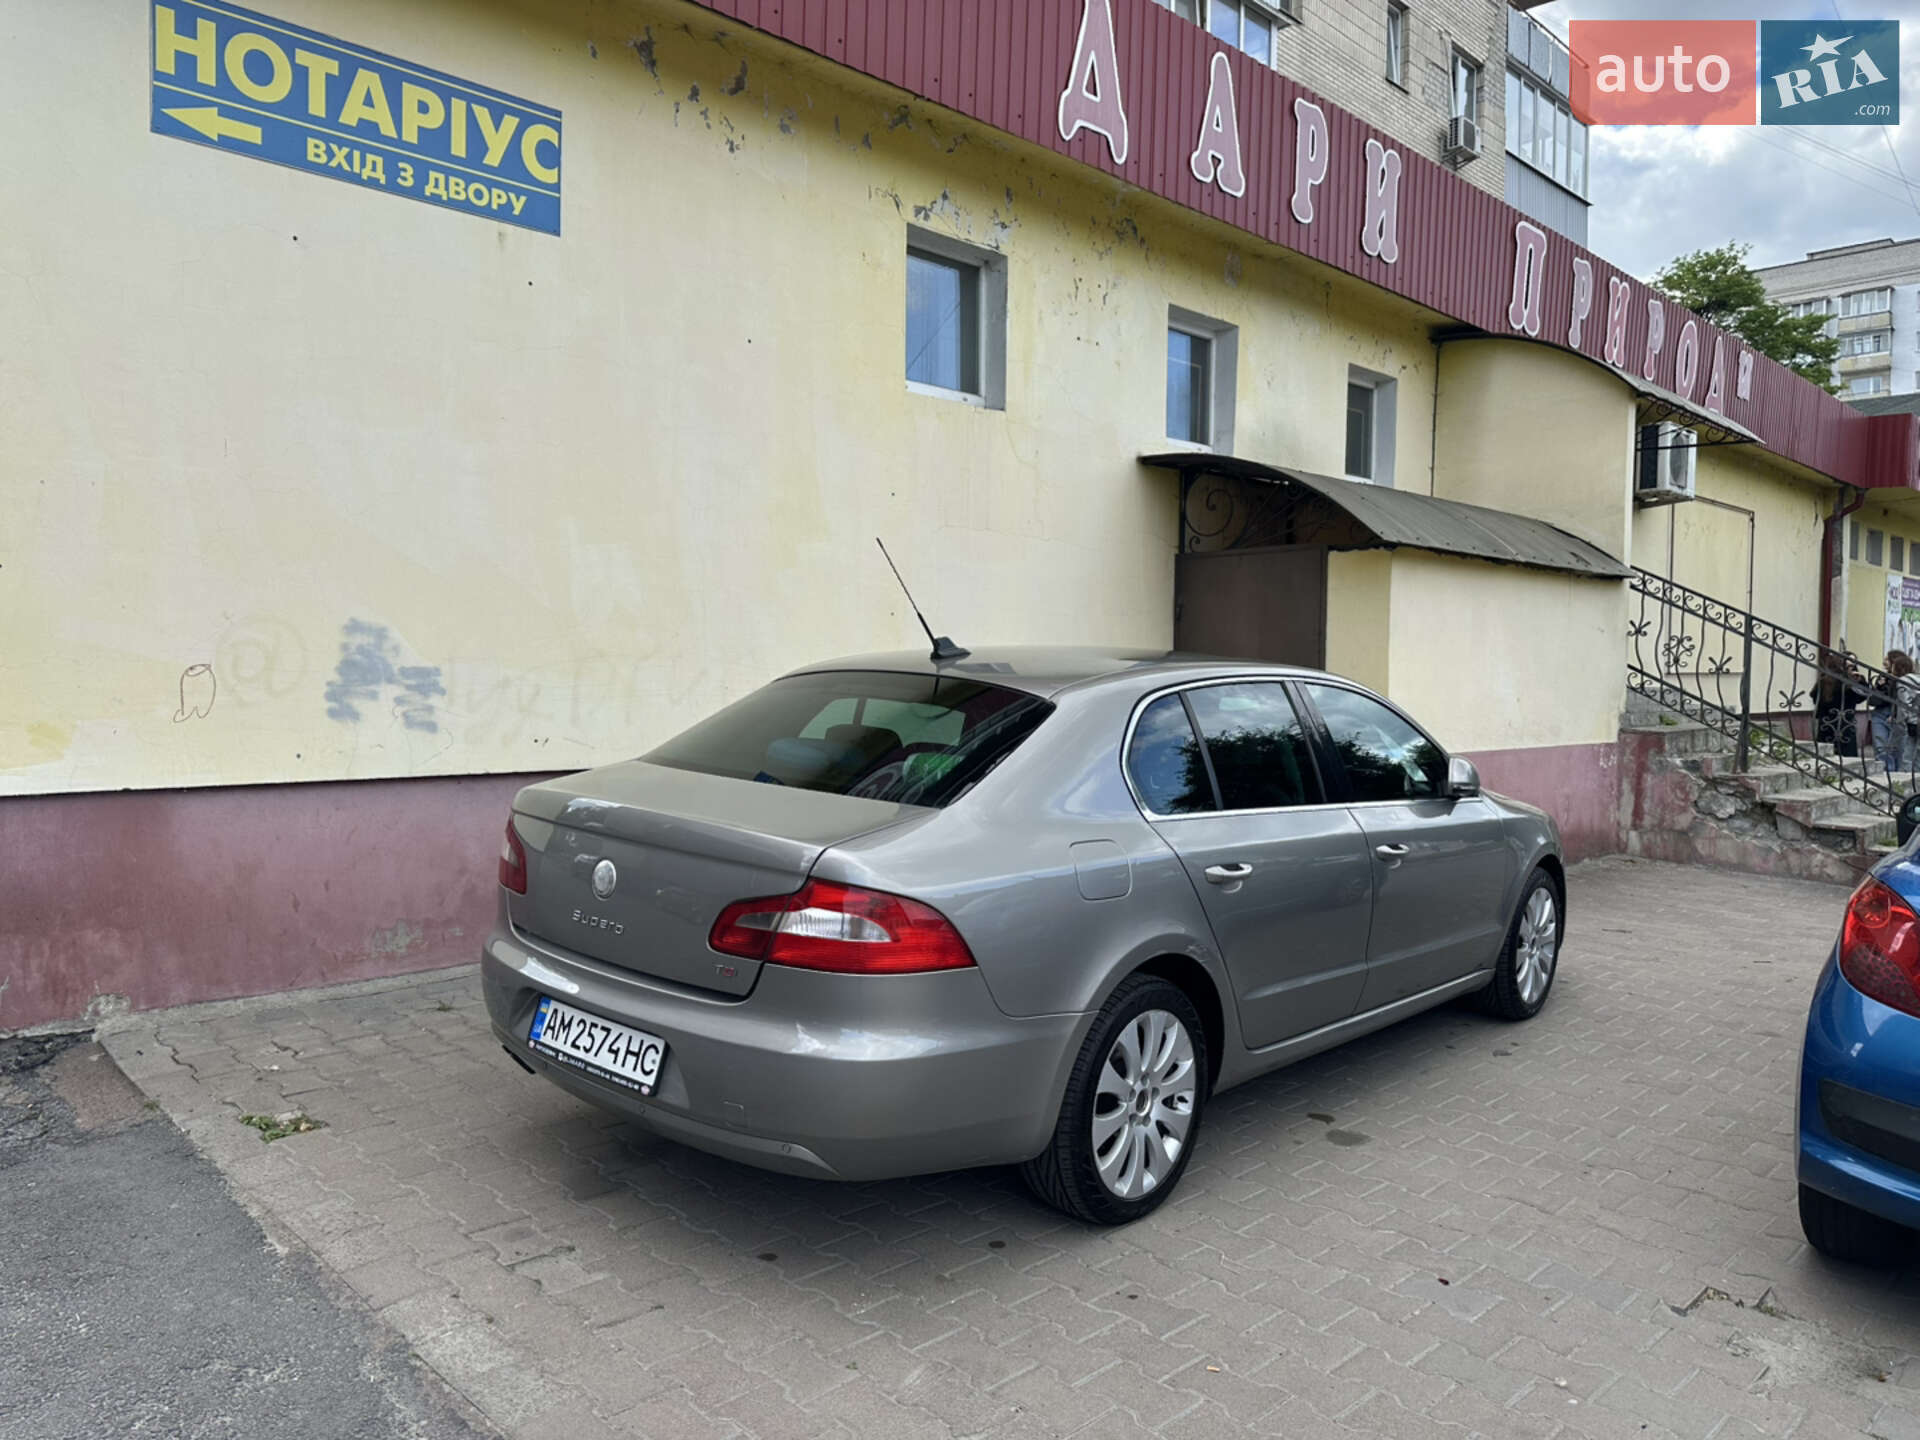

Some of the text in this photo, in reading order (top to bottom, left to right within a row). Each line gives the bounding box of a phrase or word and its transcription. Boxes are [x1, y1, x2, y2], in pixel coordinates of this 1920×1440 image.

[154, 3, 561, 184] НОТАРІУС
[1058, 0, 1402, 263] ДАРИ
[305, 136, 386, 184] ВХІД
[424, 169, 527, 216] ДВОРУ
[571, 909, 624, 934] Superb
